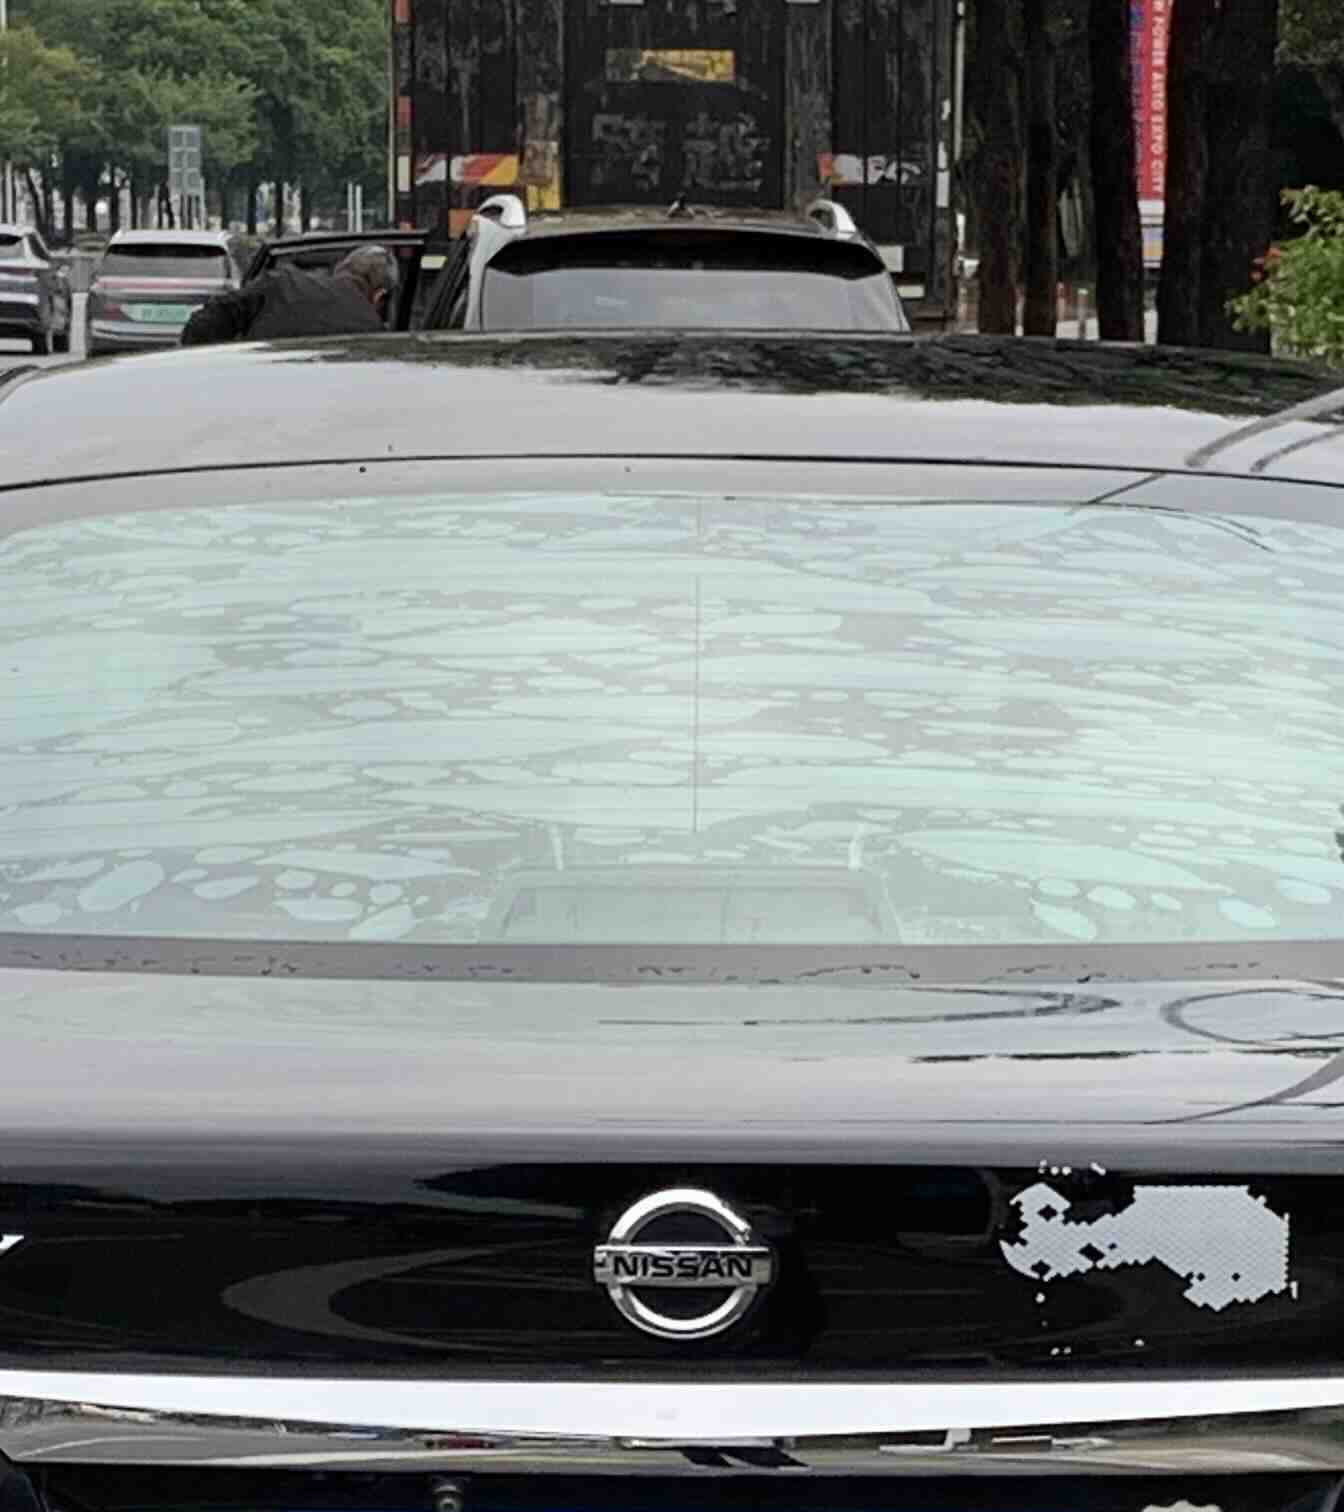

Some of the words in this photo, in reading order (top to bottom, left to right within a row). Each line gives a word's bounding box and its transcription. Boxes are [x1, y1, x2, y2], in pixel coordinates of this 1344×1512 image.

[1152, 16, 1166, 65] POWER
[1151, 71, 1166, 111] AUTO
[1151, 115, 1165, 154] EXPO
[1151, 159, 1165, 193] CITY
[613, 1255, 752, 1278] NISSAN
